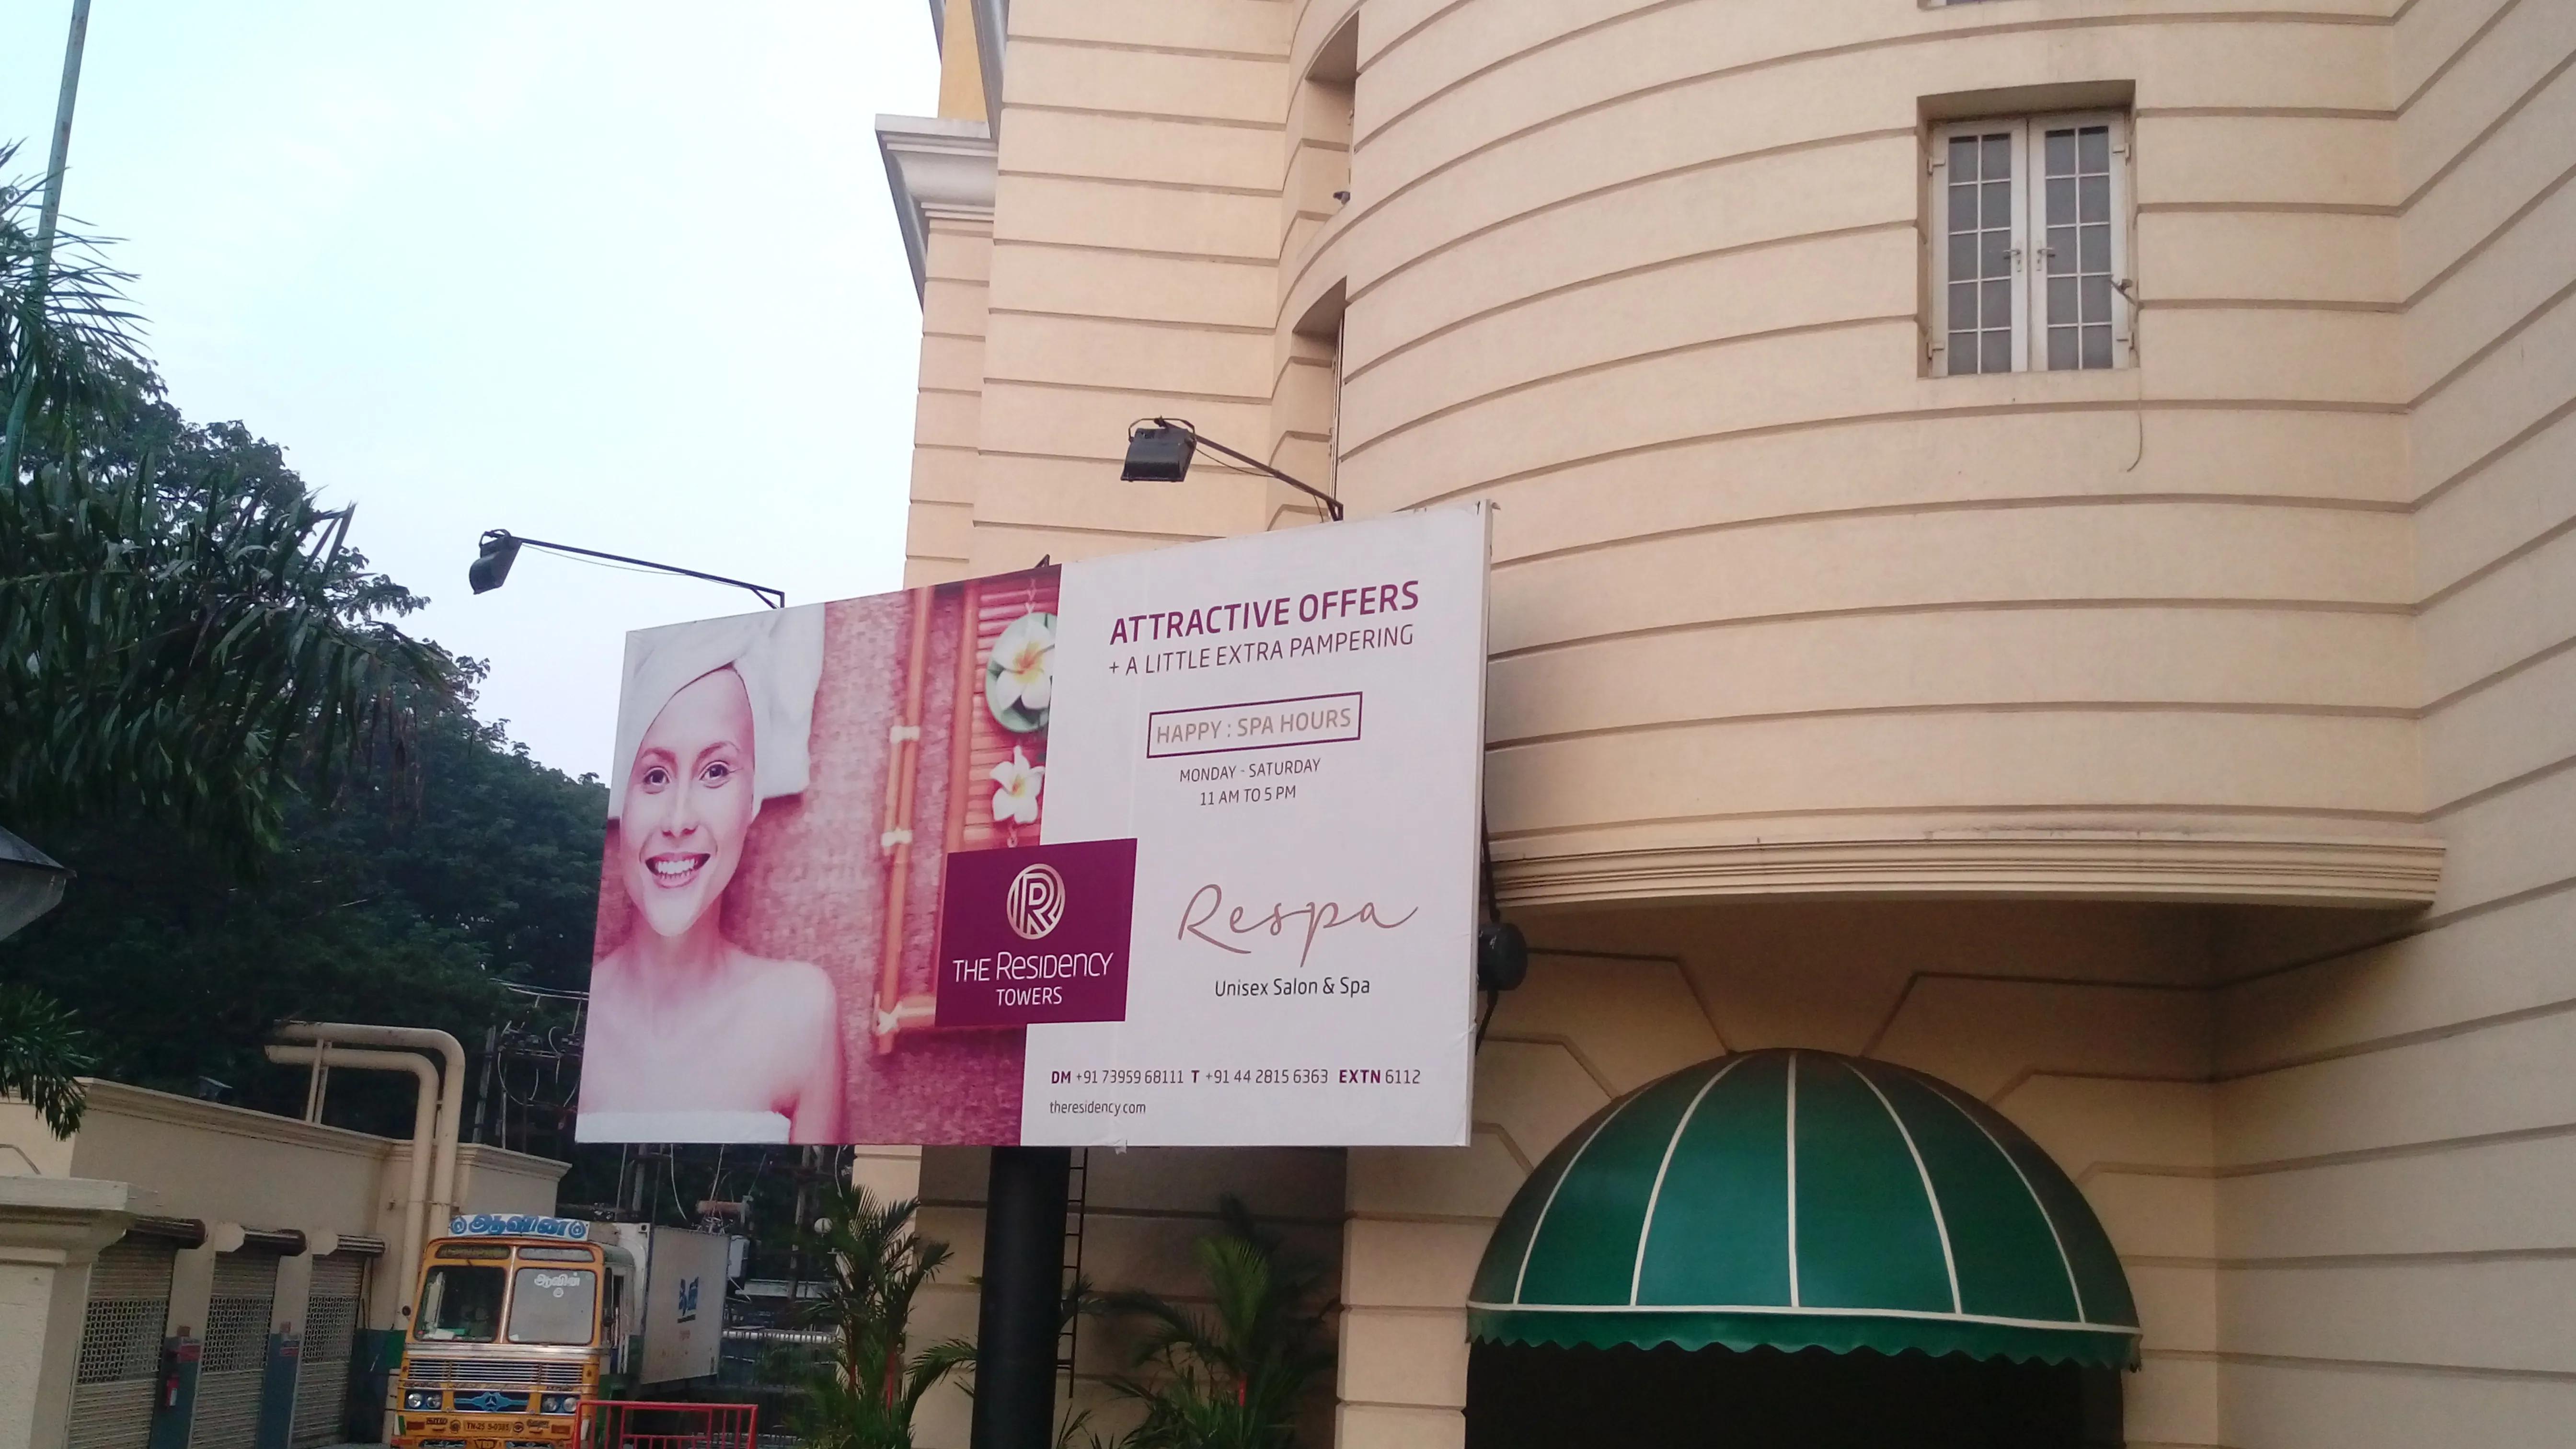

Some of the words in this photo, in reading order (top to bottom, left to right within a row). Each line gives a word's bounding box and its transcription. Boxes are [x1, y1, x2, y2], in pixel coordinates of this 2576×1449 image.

[1110, 598, 1290, 644] ATTRACTIVE
[1300, 581, 1418, 622] OFFERS
[1109, 662, 1119, 674] +
[1126, 656, 1138, 675] A
[1146, 648, 1210, 673] LITTLE
[1217, 641, 1283, 666] EXTRA
[1290, 624, 1413, 657] PAMPERING
[1157, 721, 1221, 744] HAPPY
[1238, 716, 1274, 736] SPA
[1281, 708, 1350, 733] HOURS
[1180, 766, 1236, 782] MONDAY
[1250, 758, 1321, 777] SATURDAY
[1201, 792, 1214, 805] 11
[1219, 790, 1239, 804] AM
[1244, 788, 1260, 802] TO
[1265, 787, 1271, 801] 5
[1276, 785, 1295, 799] PM
[1178, 884, 1418, 967] Respa
[953, 958, 991, 982] THE
[996, 987, 1062, 1006] TOWERS
[1216, 979, 1268, 997] Unisex
[1274, 978, 1317, 995] Salon
[1323, 978, 1334, 994] &
[1340, 977, 1369, 998] Spa
[1052, 1071, 1070, 1083] DM
[1077, 1070, 1097, 1083] +91
[1103, 1070, 1140, 1083] 73959
[1145, 1070, 1183, 1083] 68111
[1191, 1070, 1199, 1083] T
[1206, 1070, 1229, 1083] +91
[1234, 1070, 1251, 1083] 44
[1256, 1070, 1288, 1083] 2815
[1294, 1070, 1328, 1083] 6363
[1339, 1070, 1380, 1083] EXTN
[1386, 1070, 1420, 1084] 6112
